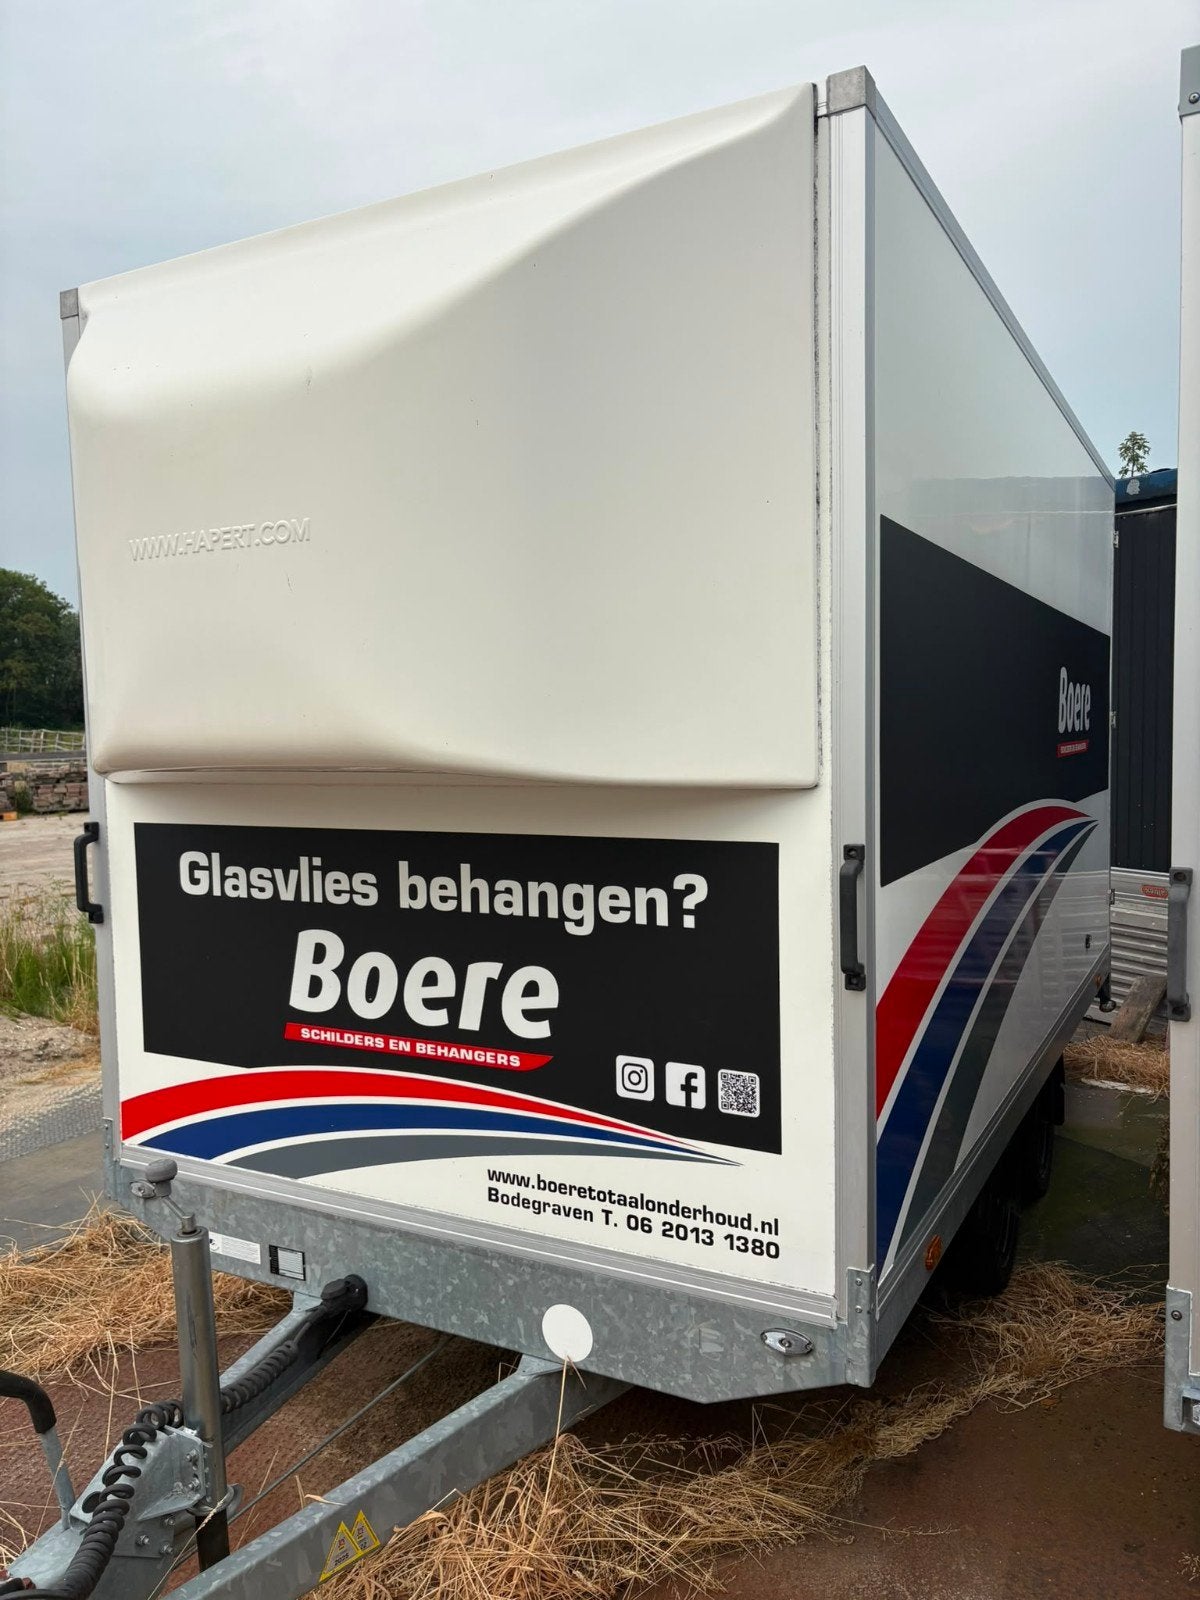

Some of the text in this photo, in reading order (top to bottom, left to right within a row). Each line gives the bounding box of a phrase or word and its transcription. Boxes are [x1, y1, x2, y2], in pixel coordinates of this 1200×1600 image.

[128, 517, 311, 562] WWW.HAPERT.COM
[1058, 666, 1091, 733] Boere
[179, 850, 708, 936] Glasvlies behangen?
[289, 929, 560, 1039] Boere
[300, 1027, 521, 1068] SCHILDERS EN BEHANGERS
[487, 1168, 780, 1237] www.boeretotaalonderhoud.nl
[487, 1186, 780, 1260] Bodegraven T. 06 2013 1380
